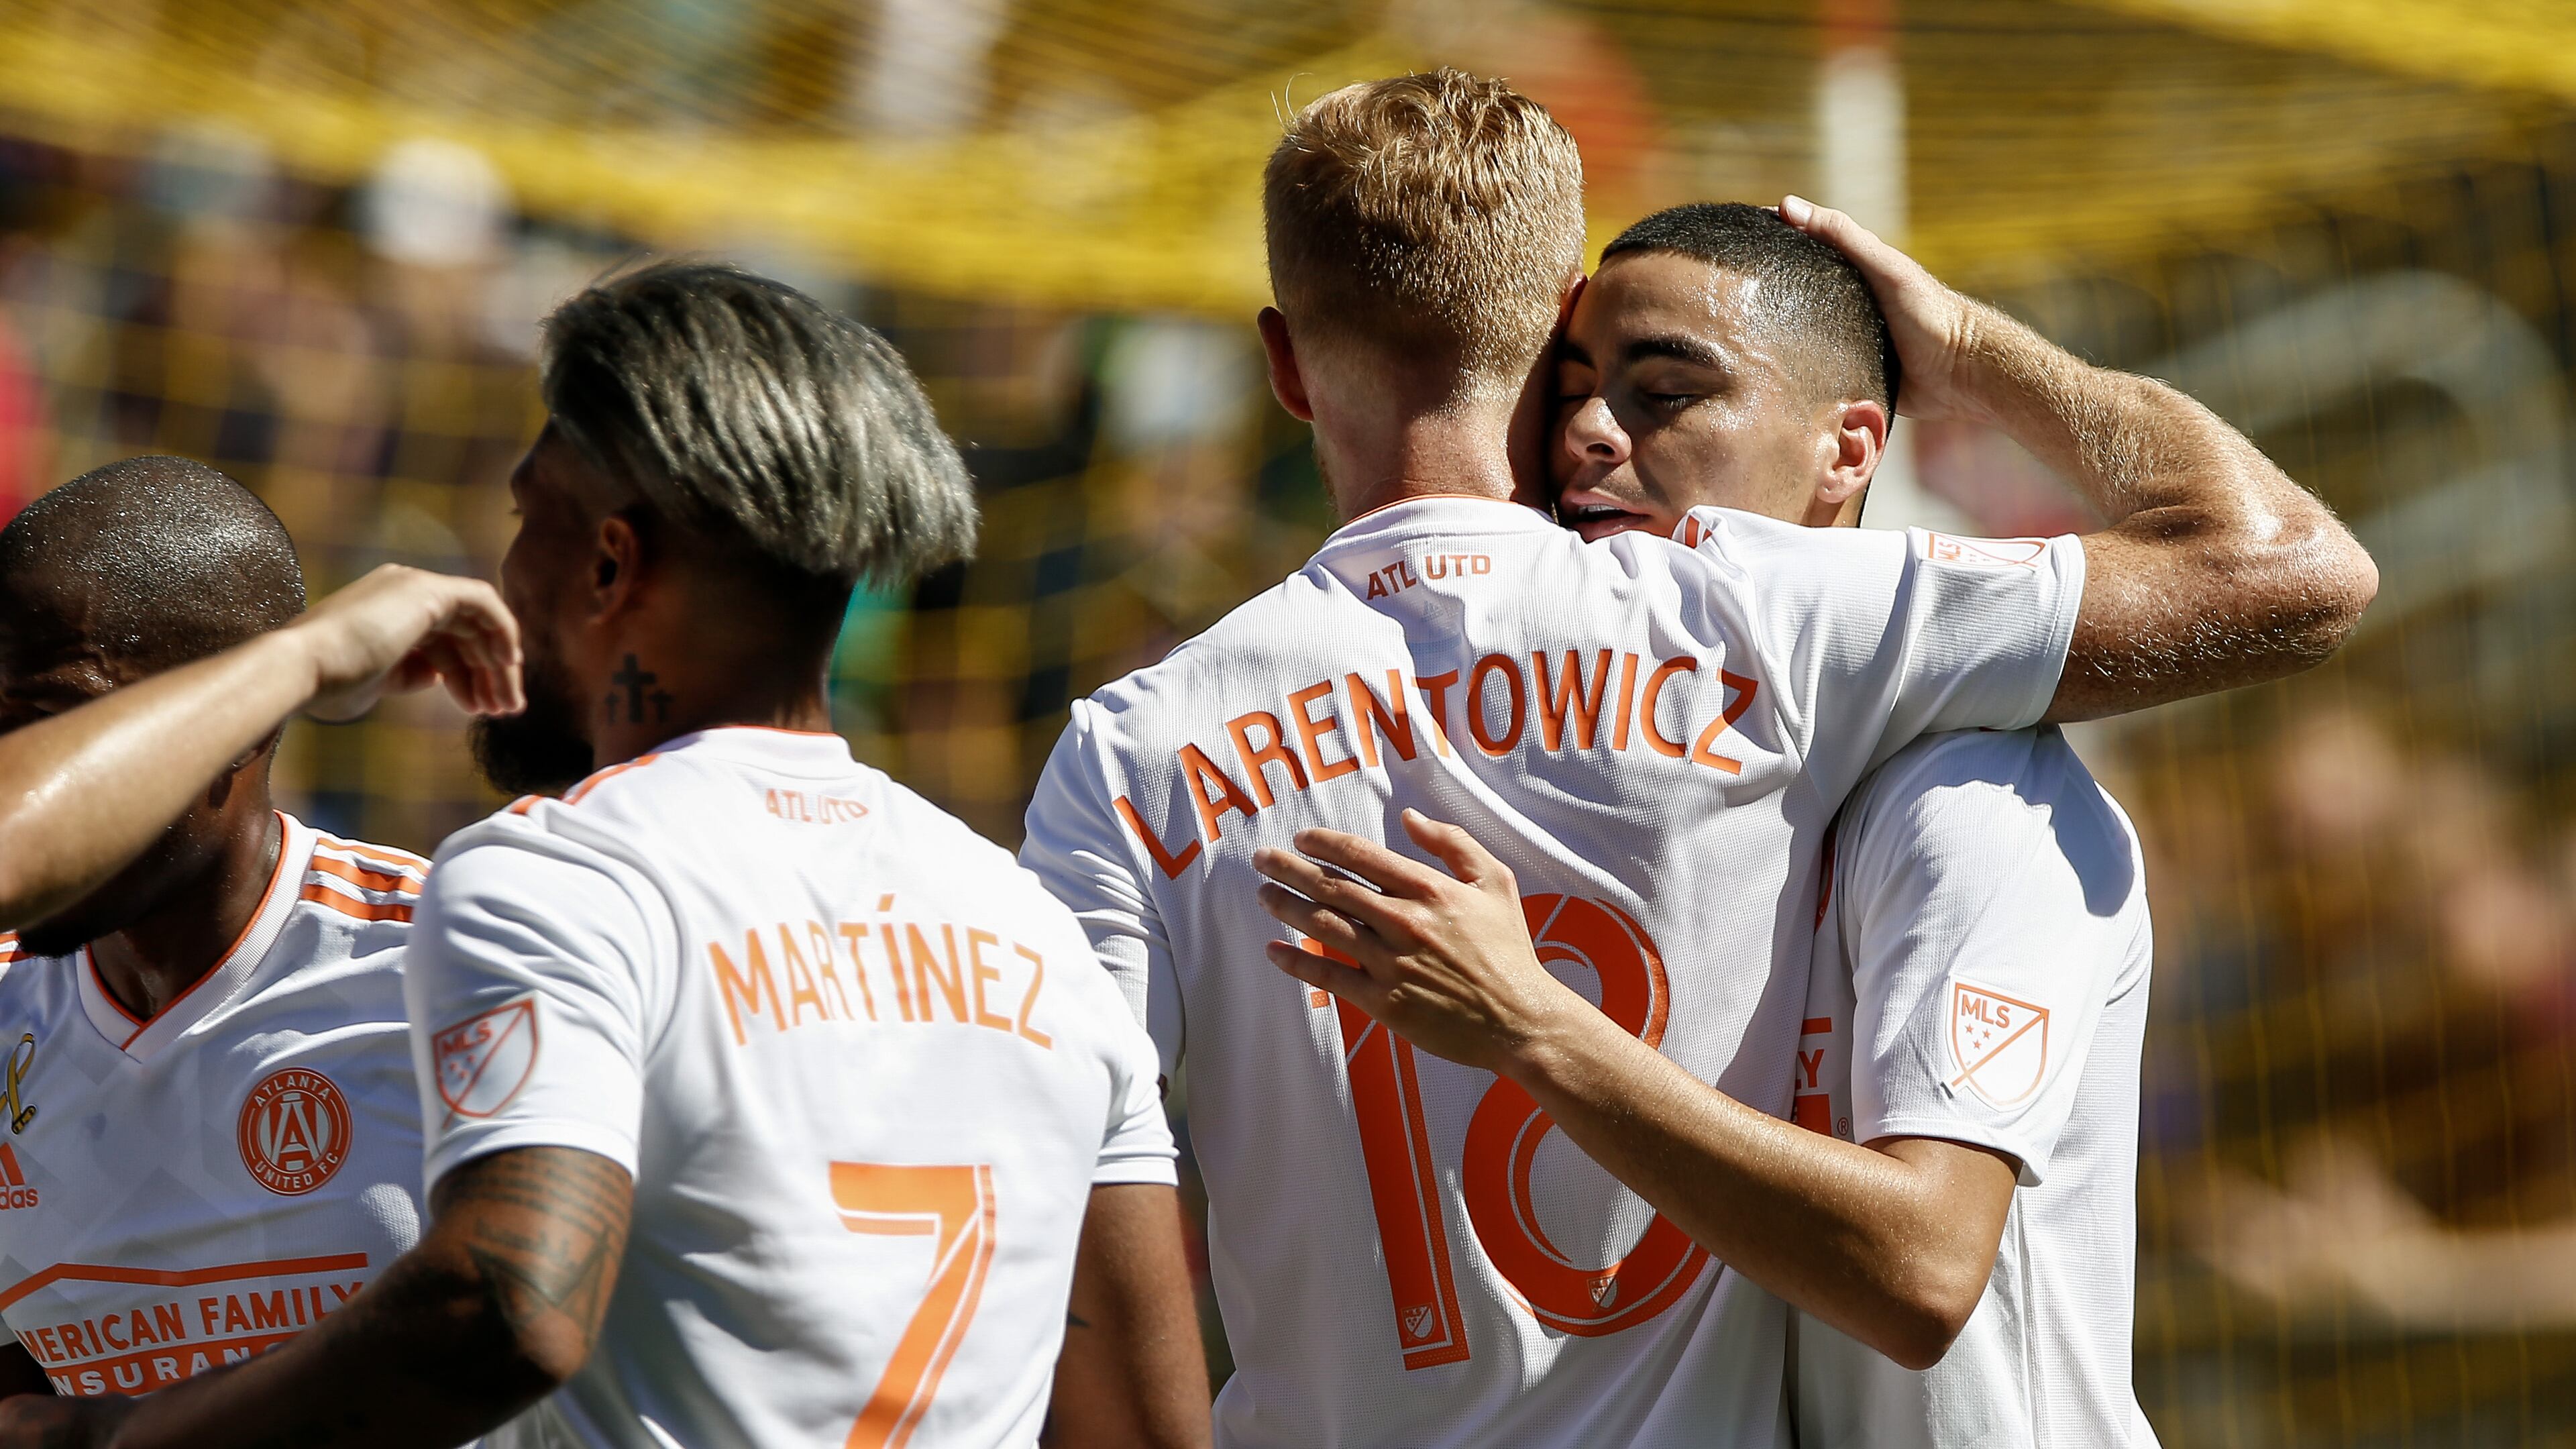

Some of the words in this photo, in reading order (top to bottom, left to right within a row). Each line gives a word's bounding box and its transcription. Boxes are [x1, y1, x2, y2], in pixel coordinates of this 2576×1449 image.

[1366, 560, 1417, 600] ATL
[1426, 555, 1491, 580] UTD
[1112, 648, 1758, 880] LARENTOWICZ
[765, 788, 812, 822] ATL
[707, 894, 1053, 1051] MARTÍNEZ
[1961, 993, 2010, 1028] MLS
[441, 1020, 494, 1058] MLS
[254, 1075, 331, 1107] ATLANTA
[1301, 893, 1711, 1371] 18
[254, 1161, 313, 1189] UNITED
[317, 1152, 338, 1175] FC
[0, 1185, 39, 1210] das
[828, 1161, 996, 1449] 7
[15, 1303, 186, 1363] MERICAN
[50, 1342, 281, 1396] NSURAN
